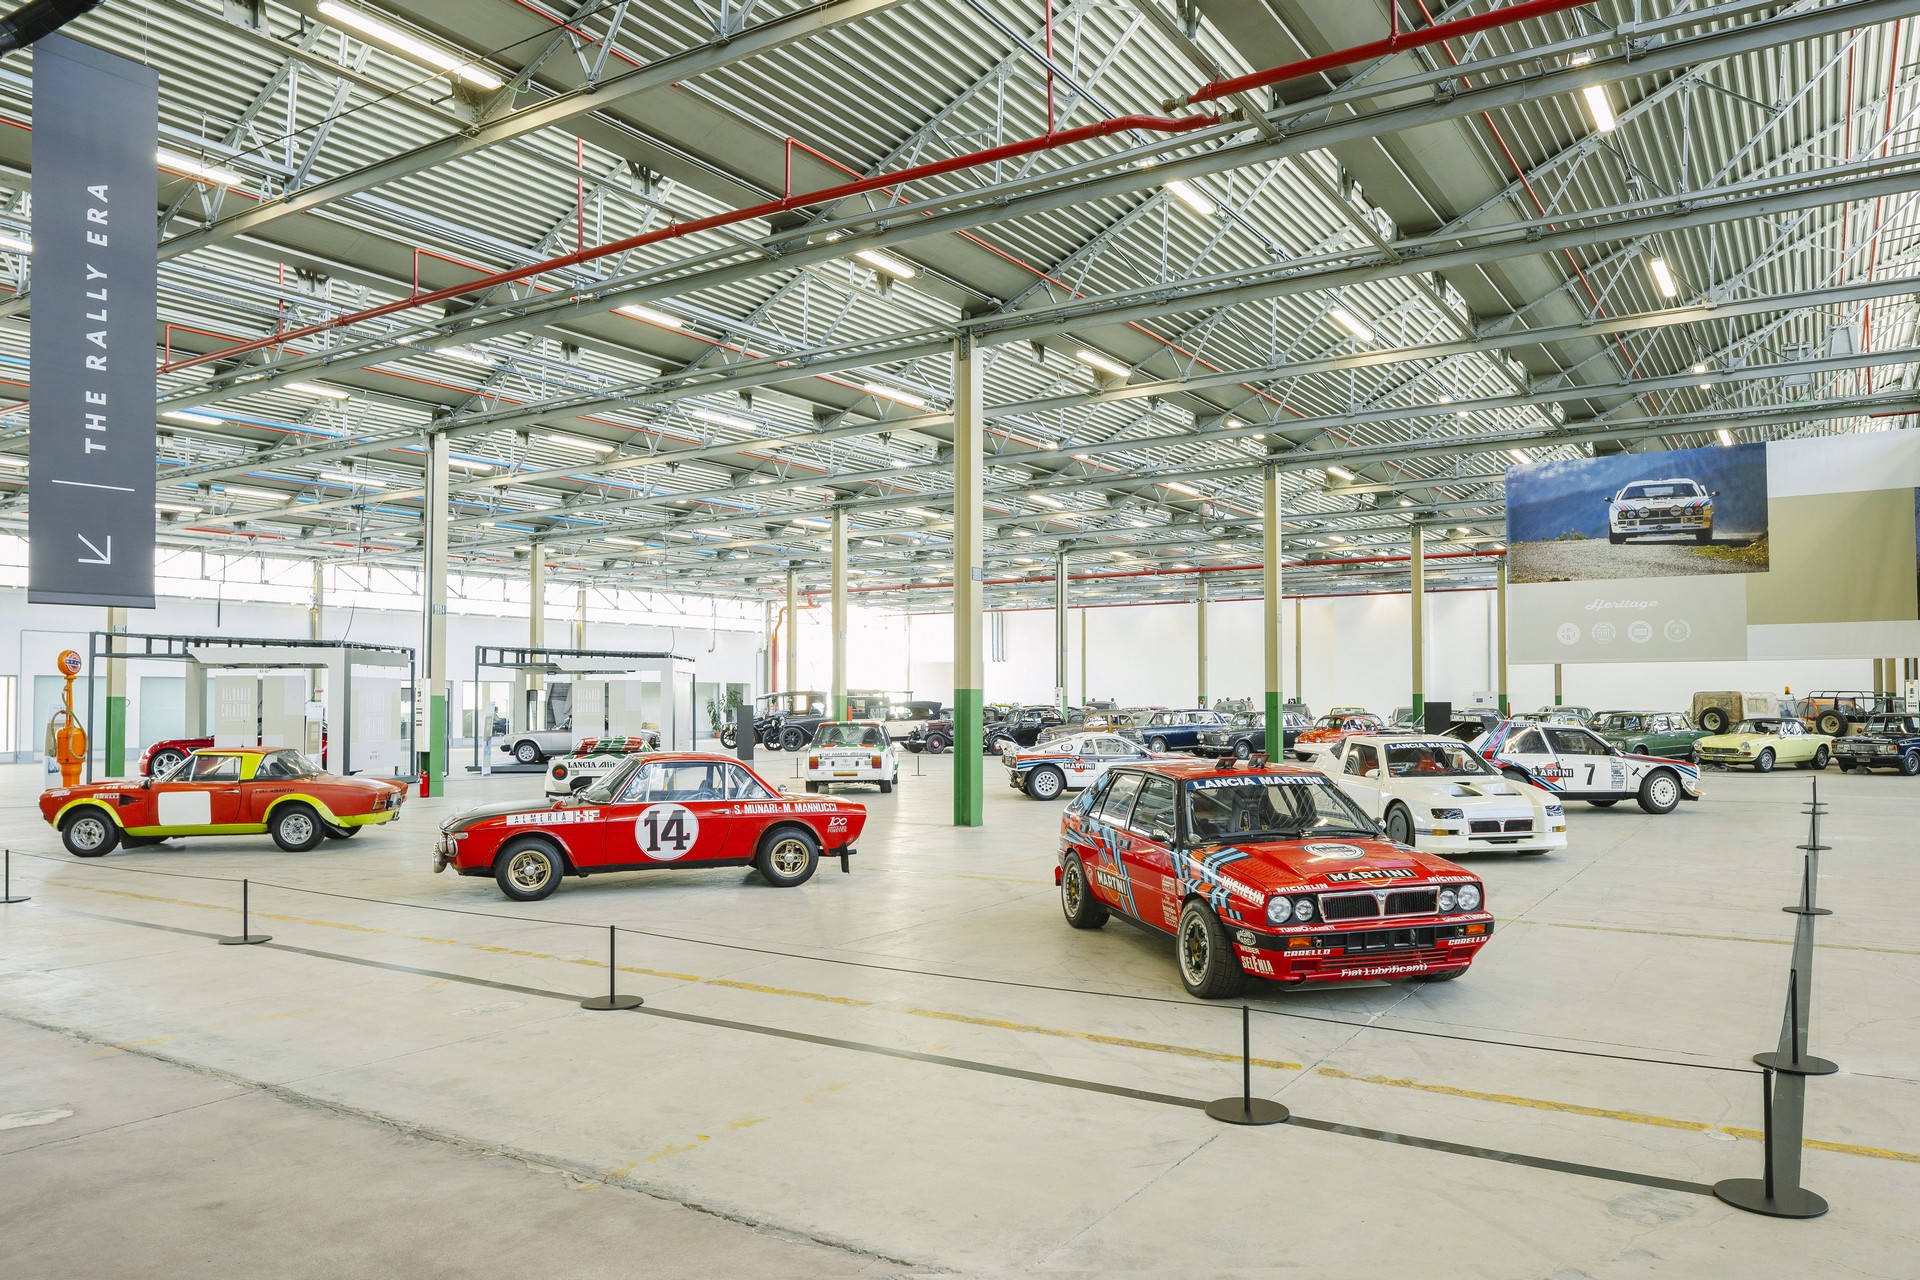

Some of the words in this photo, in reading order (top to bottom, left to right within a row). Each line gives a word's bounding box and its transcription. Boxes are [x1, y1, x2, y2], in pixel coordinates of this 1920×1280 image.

[87, 184, 109, 247] ERA
[86, 264, 108, 371] RALLY
[85, 390, 107, 453] THE
[1584, 598, 1659, 611] Heritage
[568, 761, 596, 769] LANCIA
[1532, 768, 1573, 777] MARTINI
[1584, 763, 1596, 786] 7
[1193, 777, 1257, 790] LANCIA
[1259, 776, 1324, 786] MARTINI
[733, 803, 743, 815] S.
[744, 803, 778, 815] MUNARI
[794, 803, 838, 813] MANNUCCI
[514, 812, 567, 824] ALMERIA
[643, 809, 691, 852] 14
[1329, 868, 1414, 882] MARTINI
[1427, 875, 1474, 883] MICHELIN
[1096, 870, 1128, 896] MARTINI
[1221, 875, 1265, 905] MICHELIN
[1276, 883, 1329, 893] MICHELIN
[1448, 936, 1488, 946] CARELLO
[1283, 948, 1332, 957] CARELLO
[1341, 968, 1363, 977] Fiat
[1364, 962, 1428, 976] Lubrificanti
